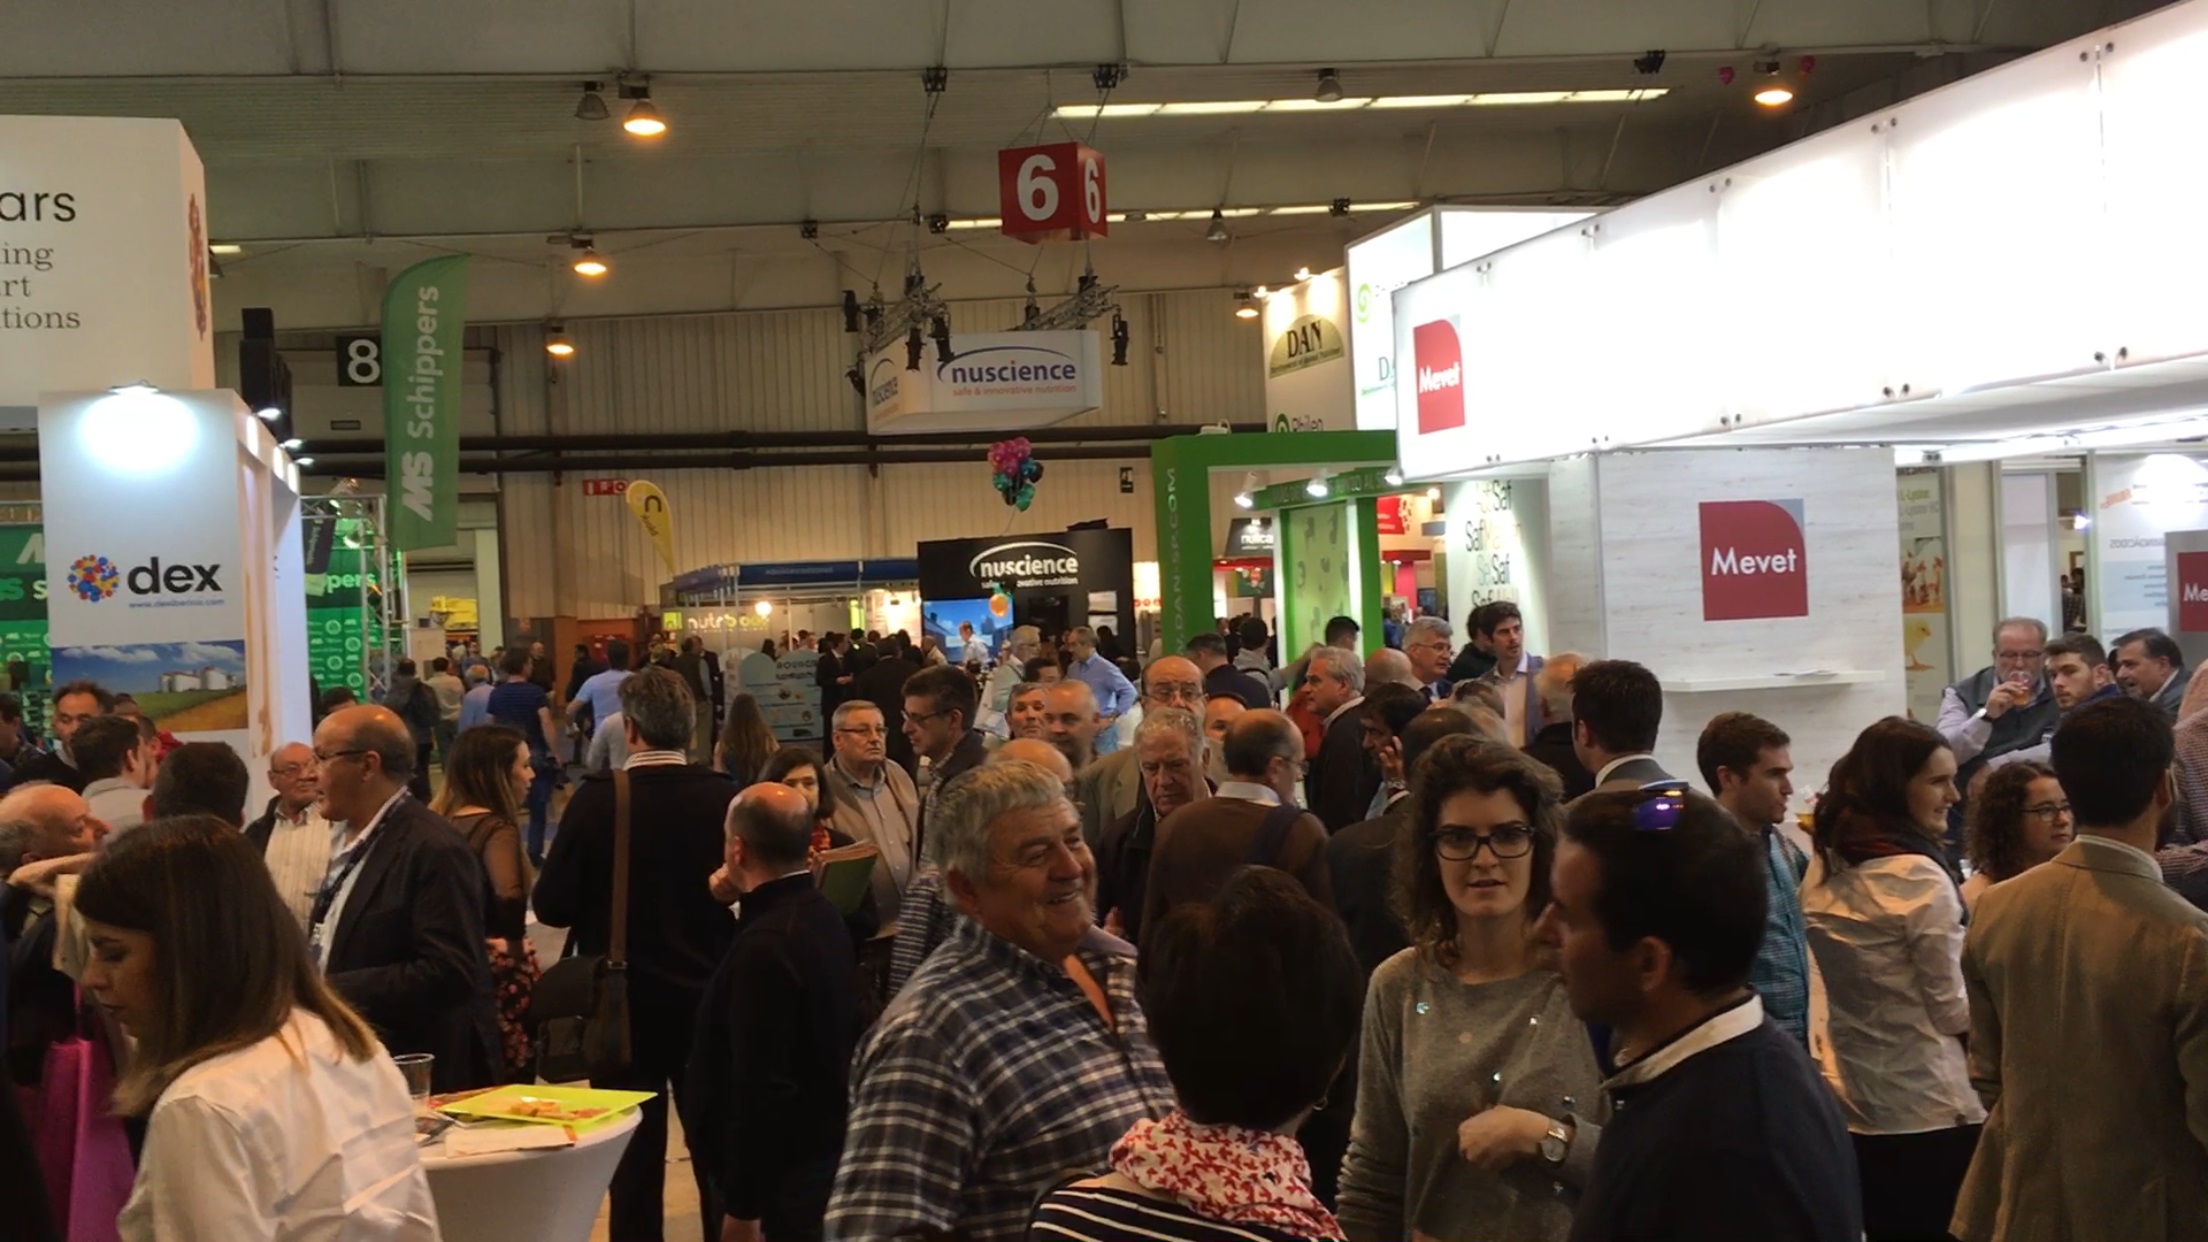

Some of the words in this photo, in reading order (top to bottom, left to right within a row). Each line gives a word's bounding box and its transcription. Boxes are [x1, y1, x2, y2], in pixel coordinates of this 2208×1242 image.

[1017, 154, 1059, 221] 6
[1084, 157, 1100, 224] 6
[0, 192, 76, 222] ars
[0, 276, 31, 298] rt
[1287, 319, 1323, 359] DAN
[348, 338, 380, 383] 8
[406, 286, 445, 439] Schippers
[952, 360, 1077, 383] nuscience
[1418, 362, 1461, 394] Mevet
[953, 386, 973, 397] safe
[974, 386, 981, 396] &
[983, 385, 1033, 396] innovative
[1035, 384, 1077, 394] nutrition
[402, 451, 434, 521] MS
[128, 556, 223, 595] dex
[981, 554, 1079, 577] nuscience
[1711, 547, 1797, 577] Mevet
